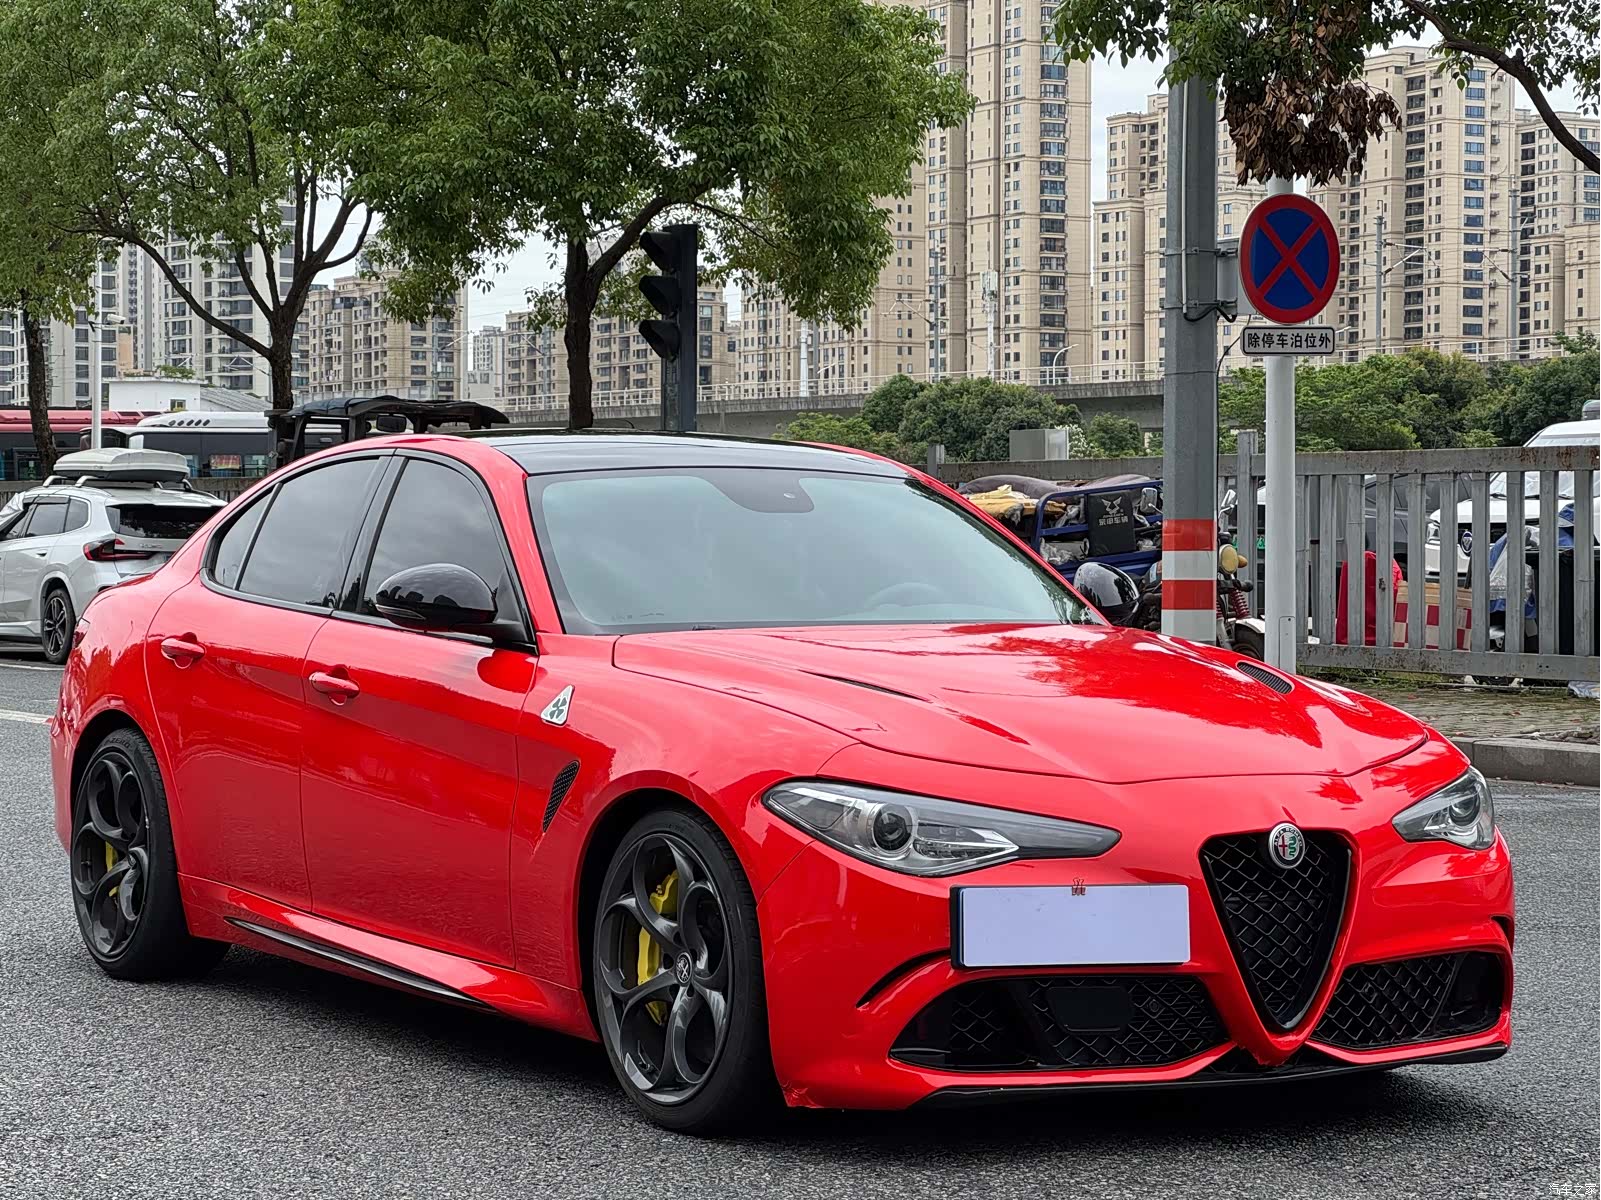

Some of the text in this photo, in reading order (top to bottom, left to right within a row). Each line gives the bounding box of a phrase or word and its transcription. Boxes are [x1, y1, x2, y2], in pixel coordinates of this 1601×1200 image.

[1247, 332, 1331, 349] 除停车泊位外
